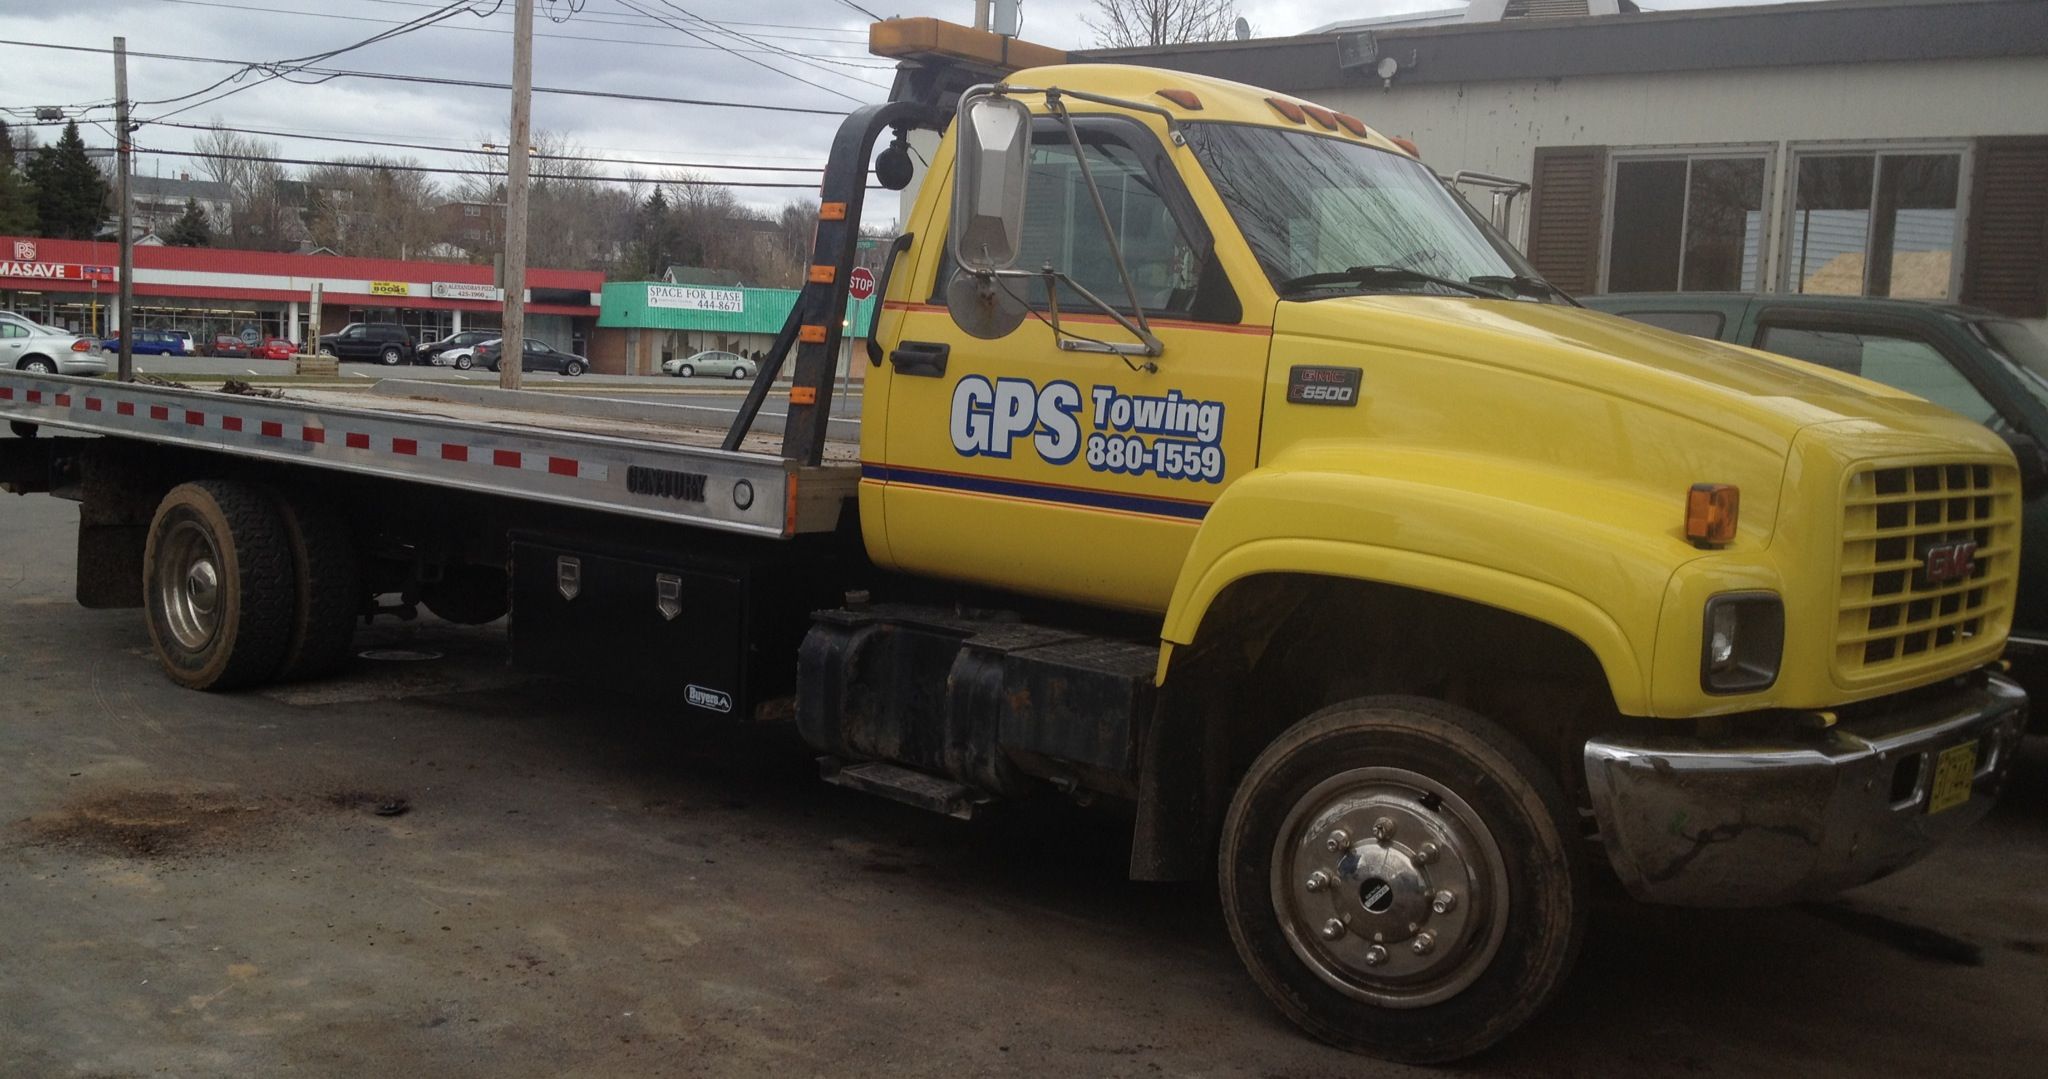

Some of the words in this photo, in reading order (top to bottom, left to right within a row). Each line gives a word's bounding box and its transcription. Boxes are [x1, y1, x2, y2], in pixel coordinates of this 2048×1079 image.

[850, 276, 873, 291] STOP
[650, 287, 683, 298] SPACE
[686, 289, 707, 299] FOR
[711, 291, 741, 302] LEASE
[697, 299, 741, 311] 444-8671
[1302, 368, 1344, 383] GMC
[950, 374, 1082, 465] GPS
[1092, 384, 1225, 444] Towing
[1087, 432, 1225, 484] 880-1559
[627, 465, 707, 503] CENTURY
[1927, 541, 1978, 580] GMC
[689, 686, 719, 705] Buyers
